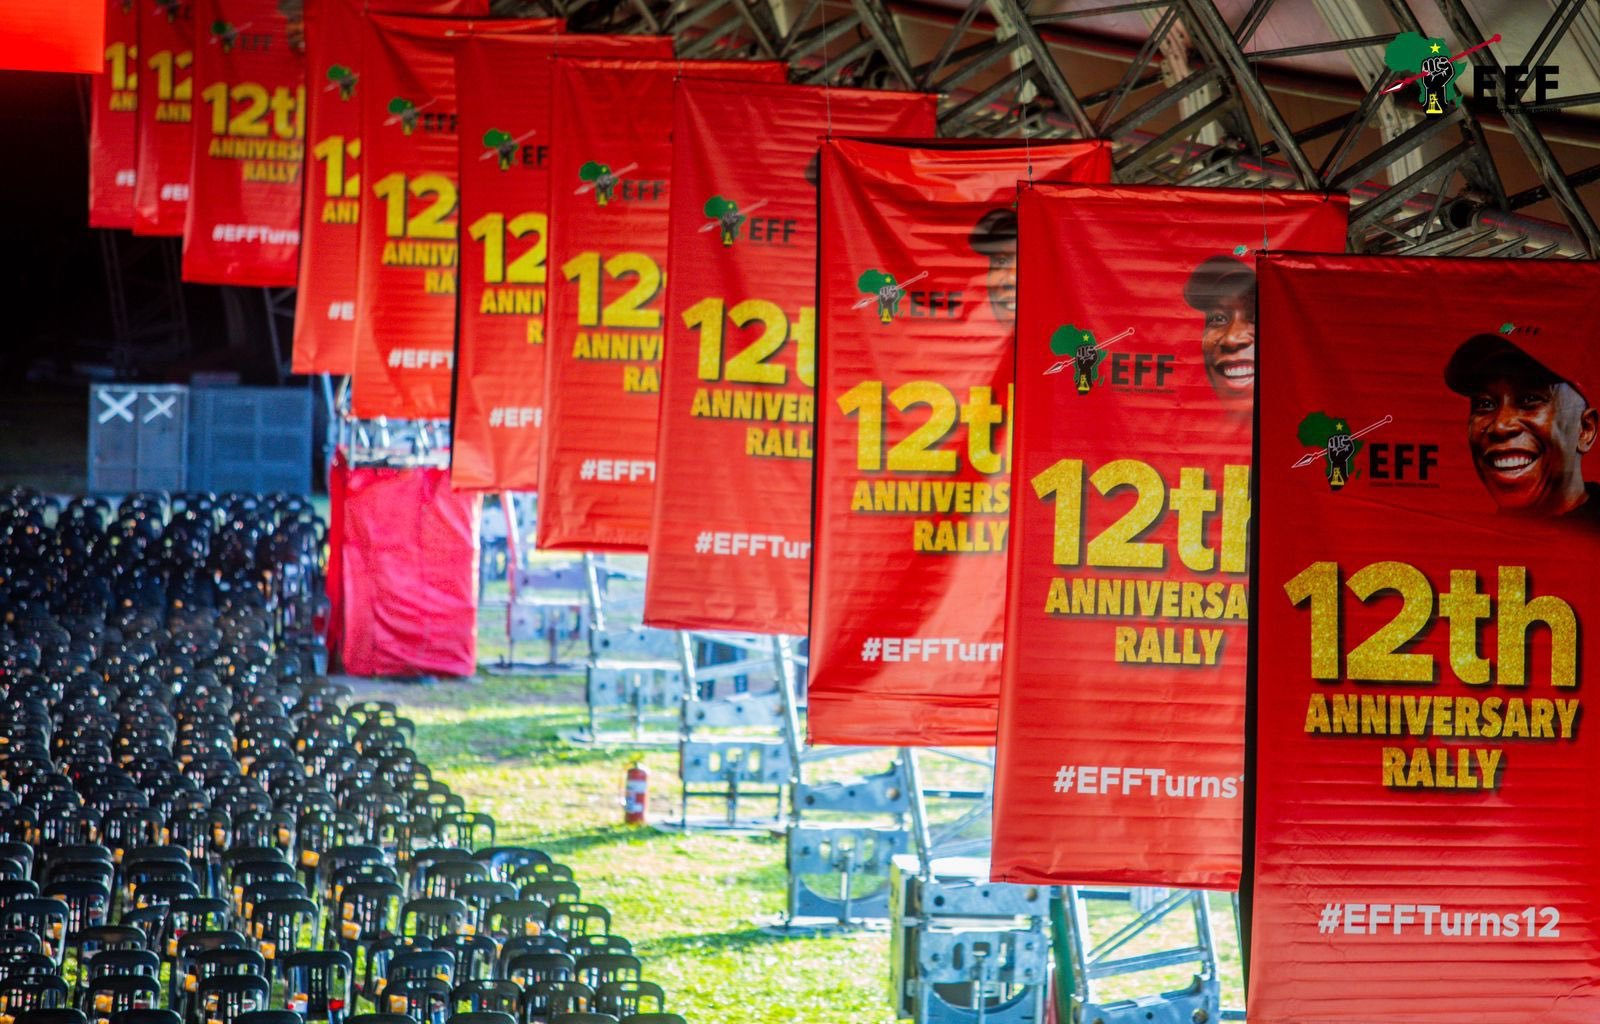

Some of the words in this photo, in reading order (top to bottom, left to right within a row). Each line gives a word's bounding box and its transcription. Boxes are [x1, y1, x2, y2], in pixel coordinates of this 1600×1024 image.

[203, 83, 305, 138] 12t
[242, 161, 299, 183] RALLY
[522, 145, 548, 166] EF
[373, 173, 458, 240] 12
[622, 180, 666, 201] EFF
[749, 217, 797, 243] EFF
[468, 212, 548, 284] 12
[910, 291, 963, 317] EFF
[1111, 353, 1175, 387] EFF
[690, 388, 814, 424] ANNIVER
[746, 427, 813, 460] RALL
[836, 380, 1014, 475] 12t
[1369, 443, 1439, 480] EFF
[851, 480, 1011, 515] ANNIVERS
[913, 520, 1010, 553] RALLY
[1044, 577, 1249, 620] ANNIVERSA
[1283, 561, 1577, 687] 12th
[1114, 626, 1224, 665] RALLY
[1304, 693, 1579, 738] ANNIVERSARY
[1053, 765, 1245, 799] #EFFTurns
[1382, 747, 1503, 789] RALLY
[1318, 903, 1560, 937] #EFFTurns12
